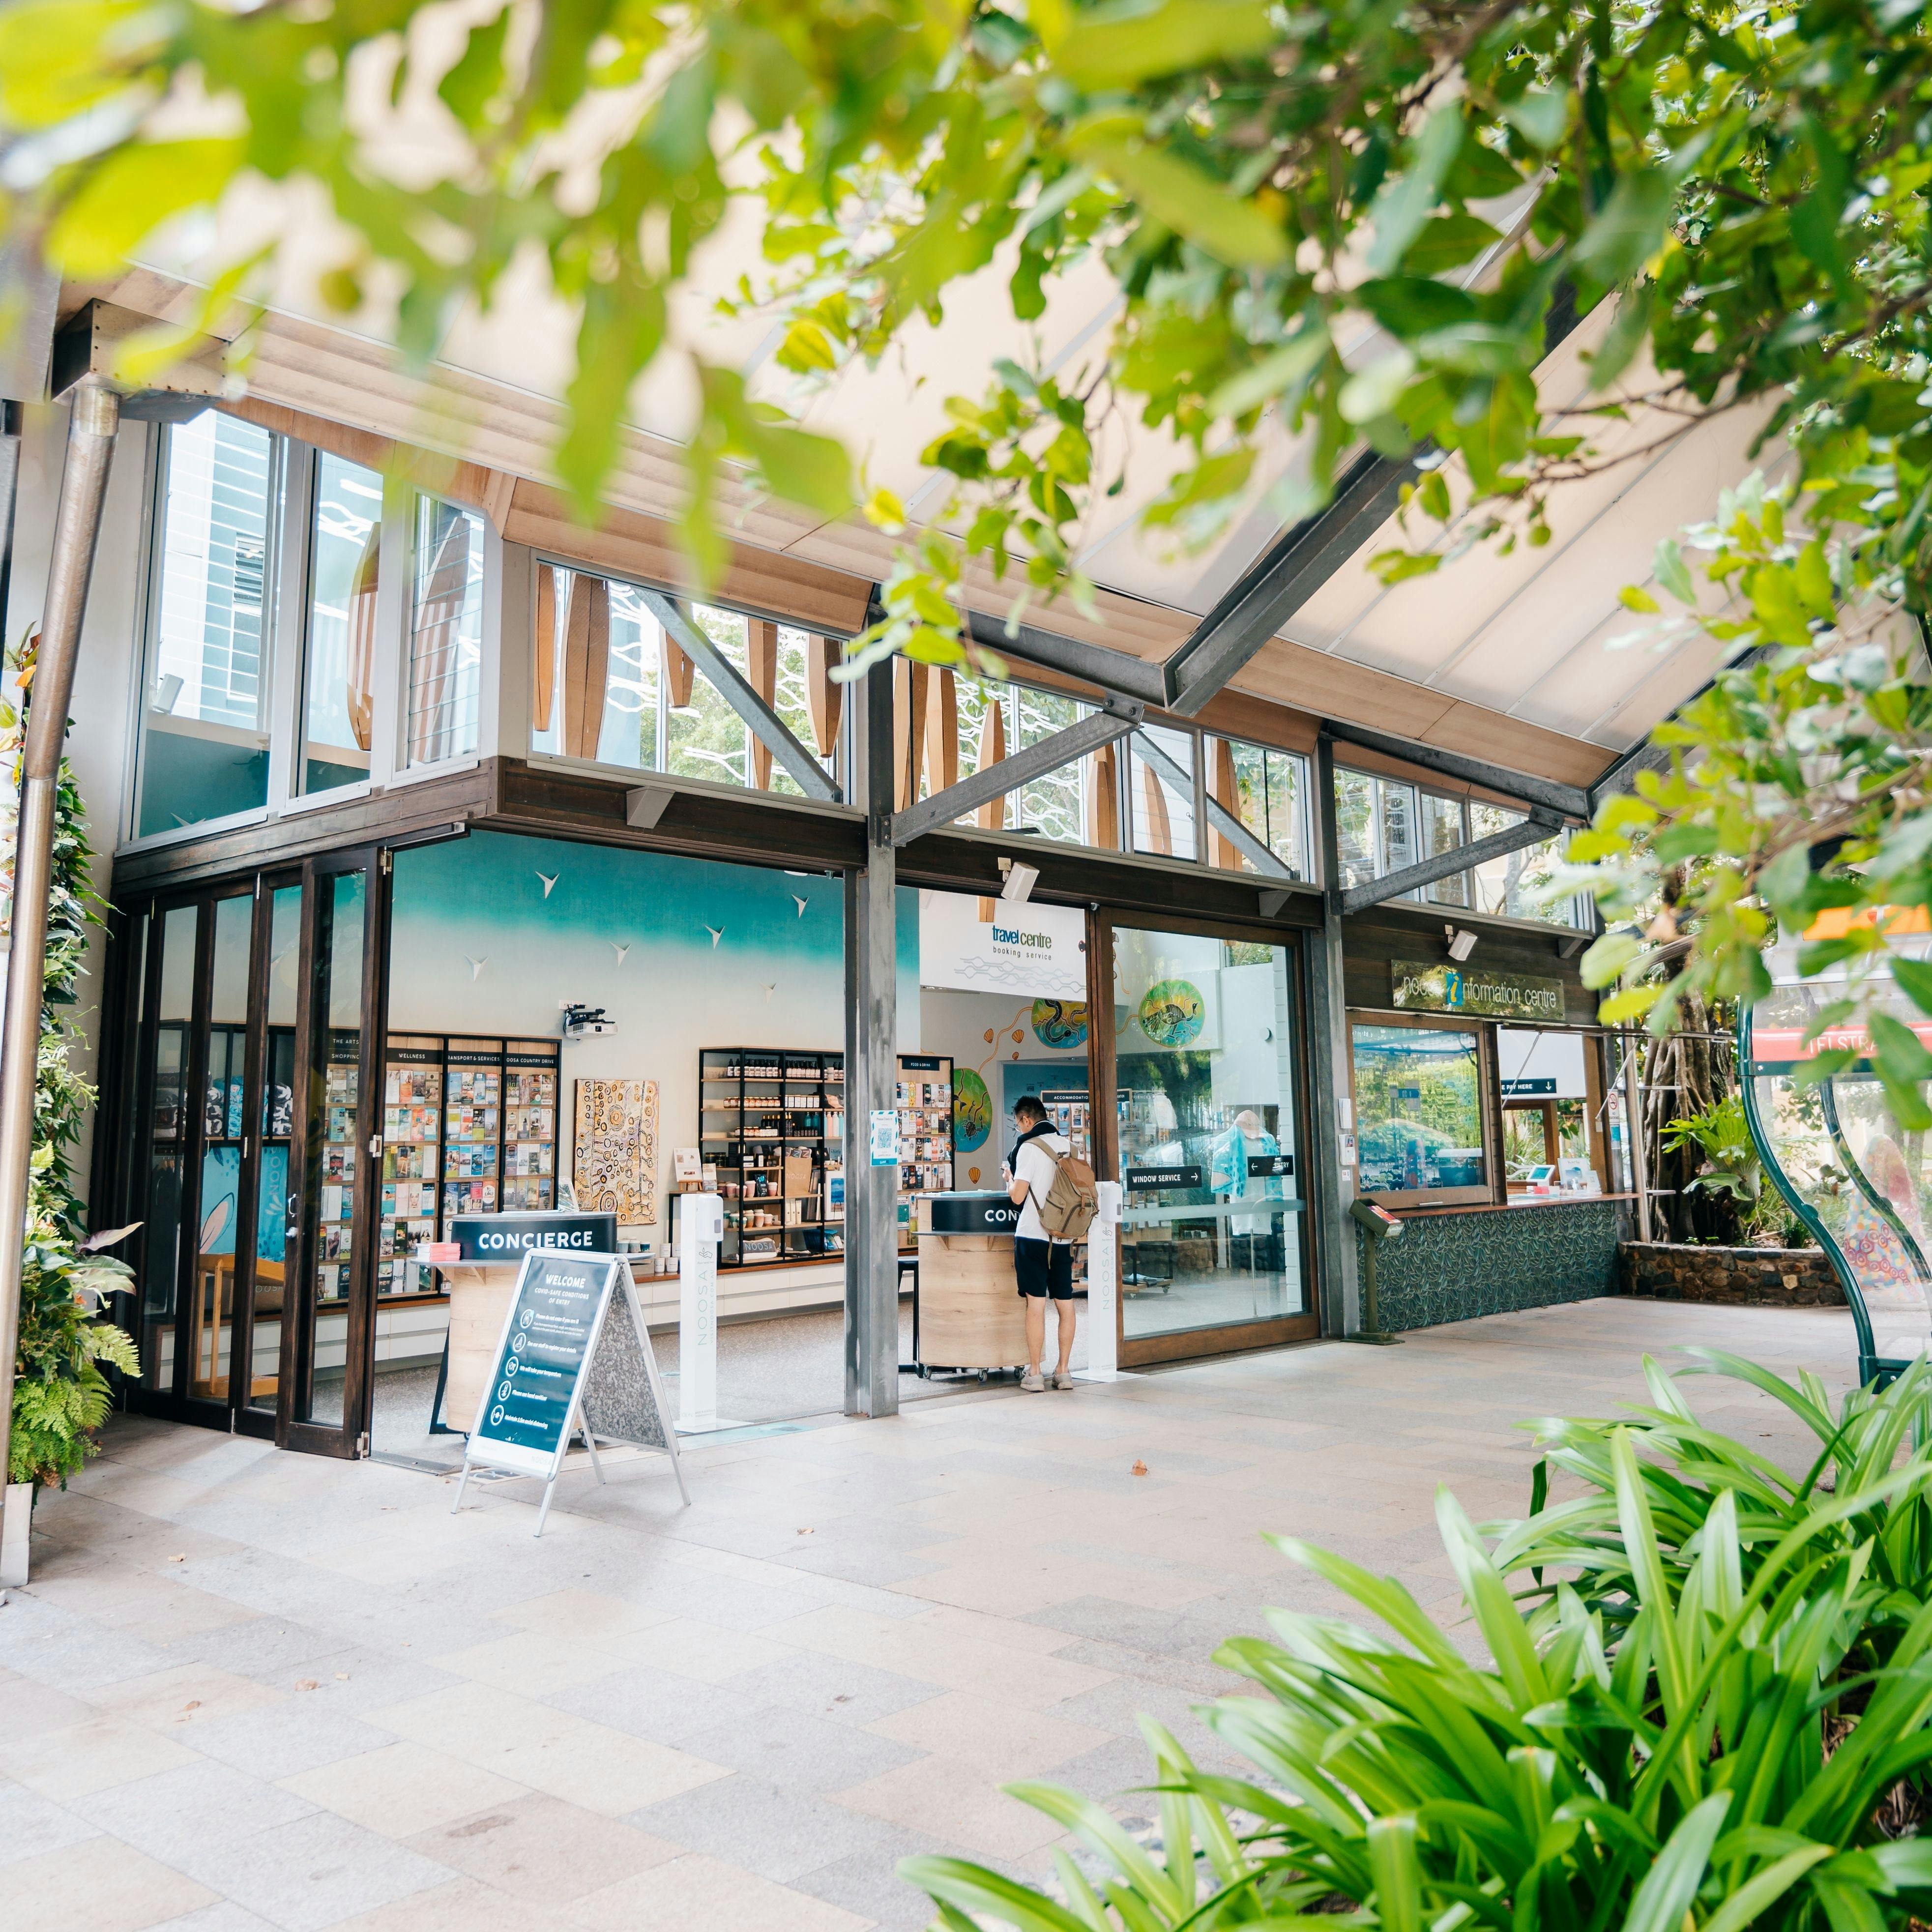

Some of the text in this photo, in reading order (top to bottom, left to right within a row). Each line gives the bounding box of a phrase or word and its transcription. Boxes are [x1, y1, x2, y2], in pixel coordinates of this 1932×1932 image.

[993, 925, 1052, 949] travel centre
[993, 946, 1021, 958] booking
[1524, 988, 1556, 1008] centre
[269, 1146, 281, 1195] NOOS
[985, 1209, 1017, 1222] CON
[479, 1231, 592, 1249] CONCIERGE
[546, 1274, 586, 1288] WELCOME
[535, 1288, 589, 1299] COVID-SAFE CONDITIONS
[698, 1270, 707, 1345] NOOSA
